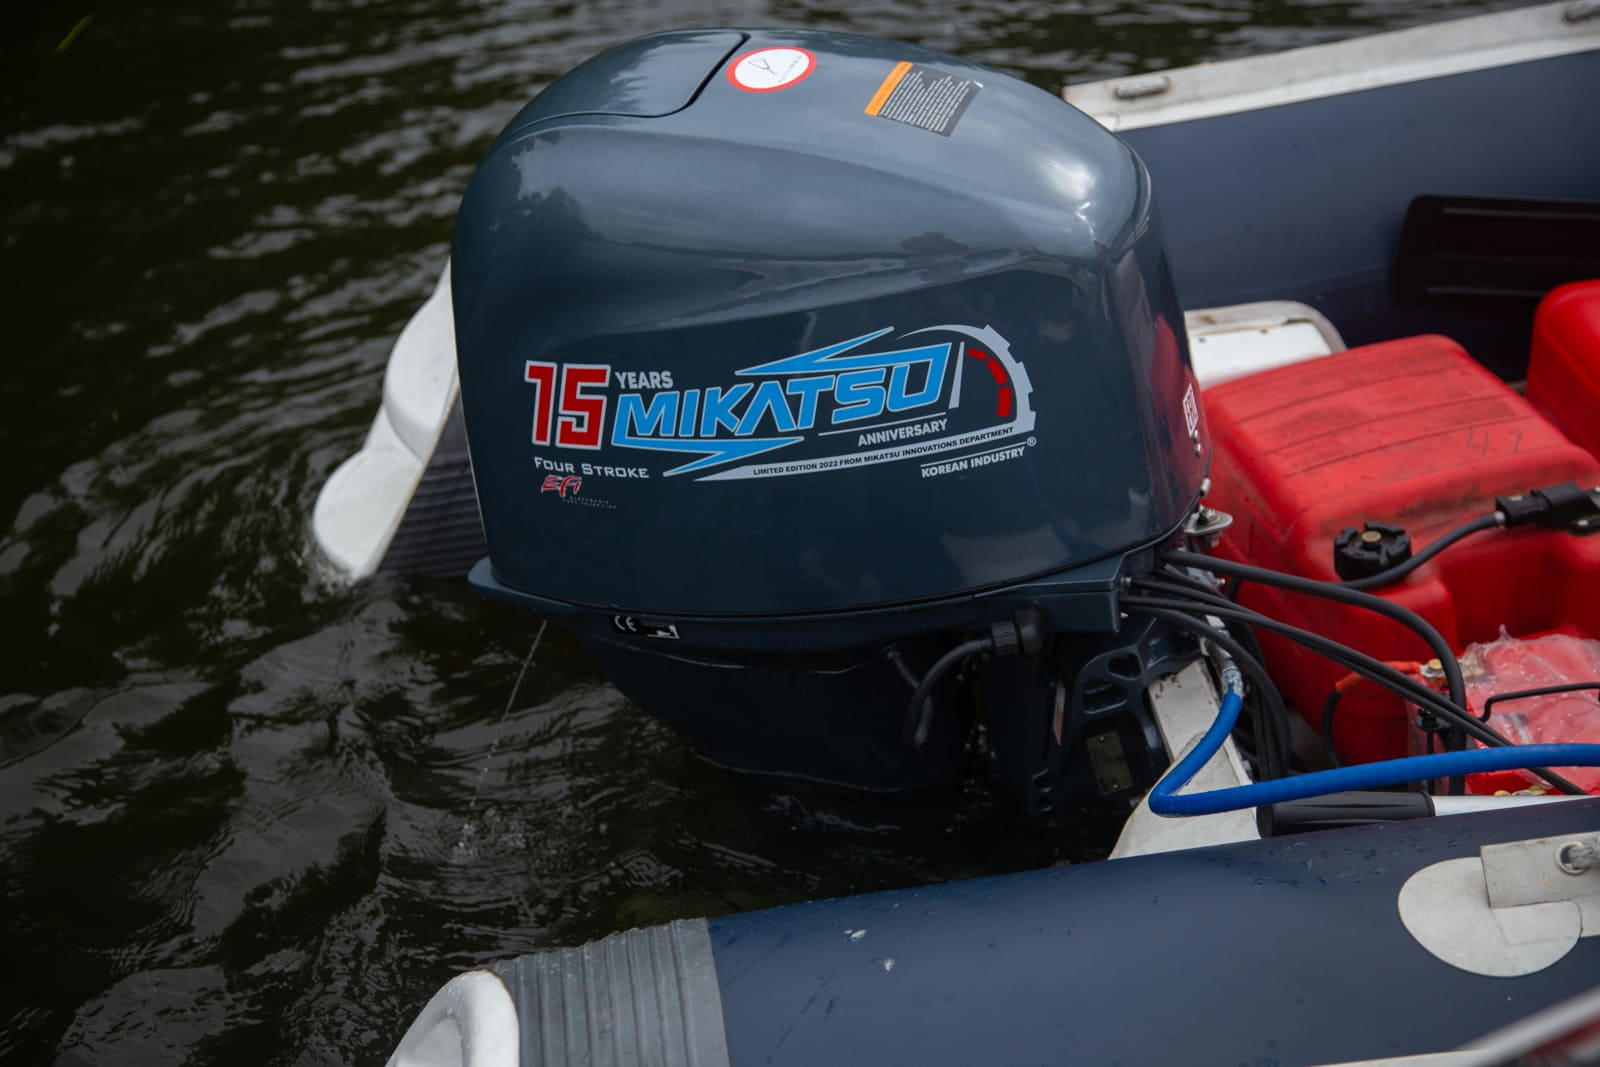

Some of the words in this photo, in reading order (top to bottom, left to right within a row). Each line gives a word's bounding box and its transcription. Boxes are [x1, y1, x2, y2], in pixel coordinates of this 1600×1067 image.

[611, 341, 954, 452] MIKATSU
[614, 371, 674, 389] YEARS
[524, 360, 611, 450] 15
[857, 418, 949, 447] ANNIVERSARY
[534, 456, 576, 474] FOUR
[581, 463, 650, 479] STROKE
[753, 466, 784, 476] LIMITED
[785, 463, 817, 473] EDITION
[819, 461, 838, 469] 2022
[839, 457, 862, 467] FROM
[863, 449, 900, 464] MIKATSU
[902, 439, 958, 457] INNOVATIONS
[959, 426, 1014, 446] DEPARTMENT
[921, 461, 968, 479] KOREAN
[970, 446, 1025, 468] INDUSTRY
